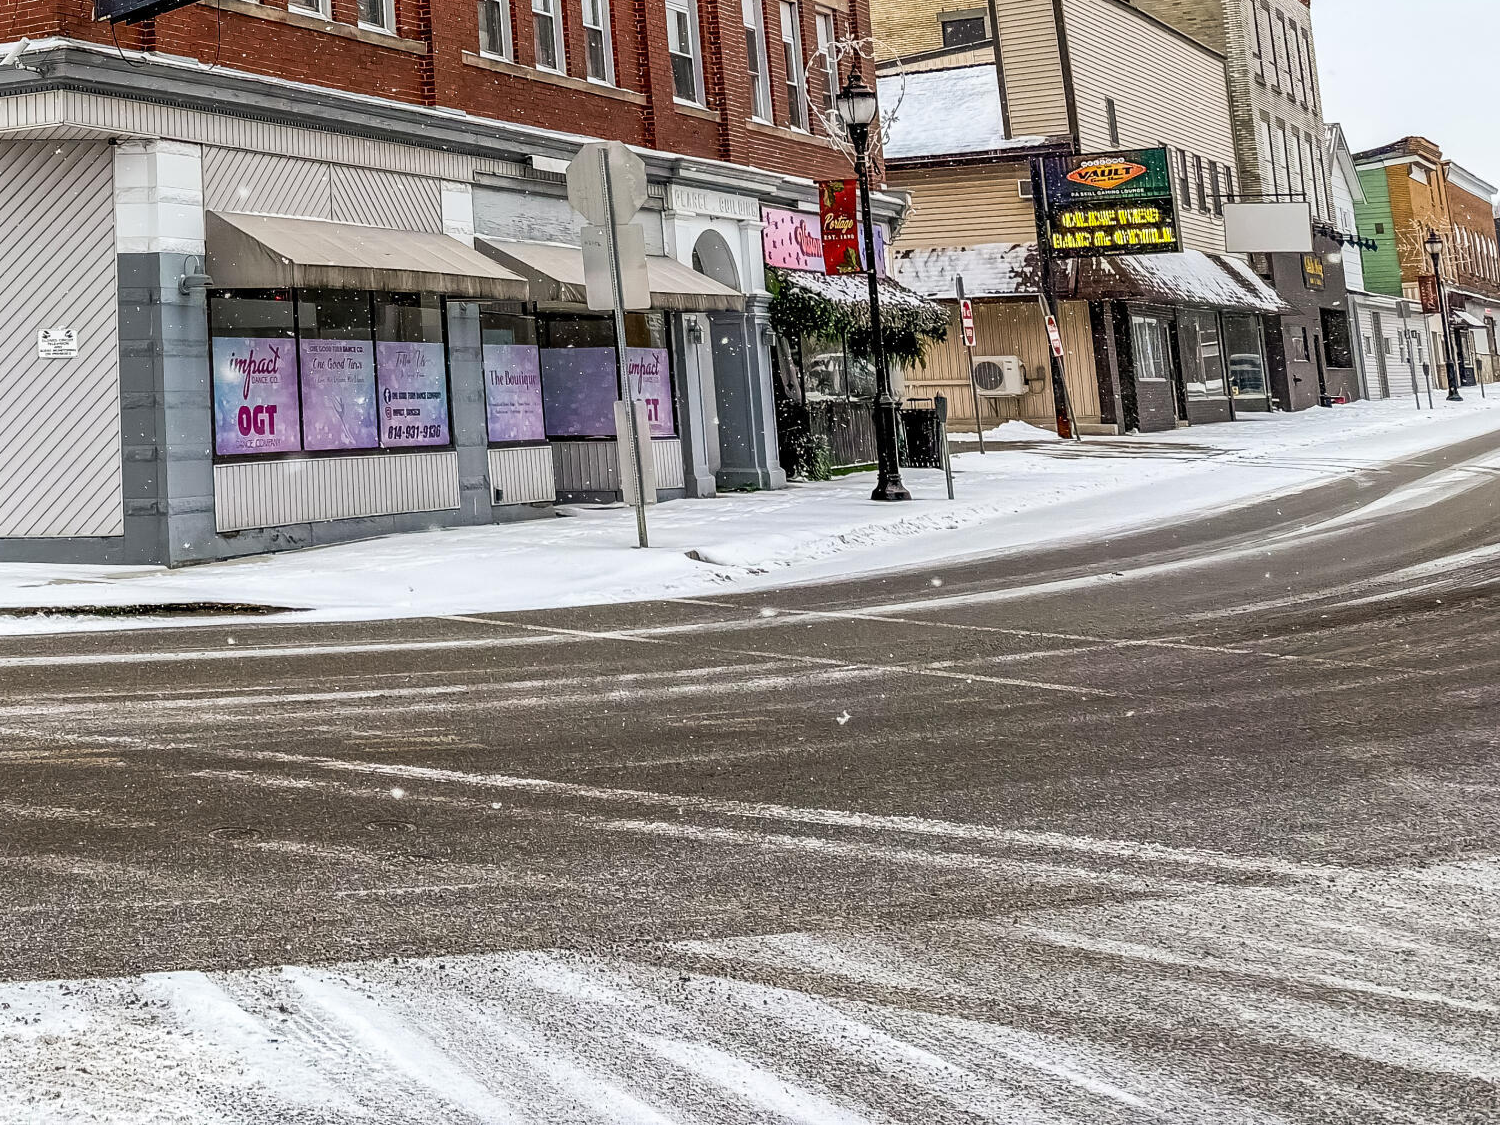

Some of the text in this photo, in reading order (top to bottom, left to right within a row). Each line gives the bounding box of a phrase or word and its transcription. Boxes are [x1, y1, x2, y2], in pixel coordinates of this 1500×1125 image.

[1077, 165, 1134, 181] VAULT
[720, 197, 758, 218] BUILDING
[823, 213, 854, 233] Portage
[229, 344, 280, 400] impact
[328, 357, 345, 370] Good
[628, 352, 660, 394] impact
[251, 376, 268, 384] DANCE
[490, 369, 536, 390] The Boutique
[238, 405, 277, 436] OGT
